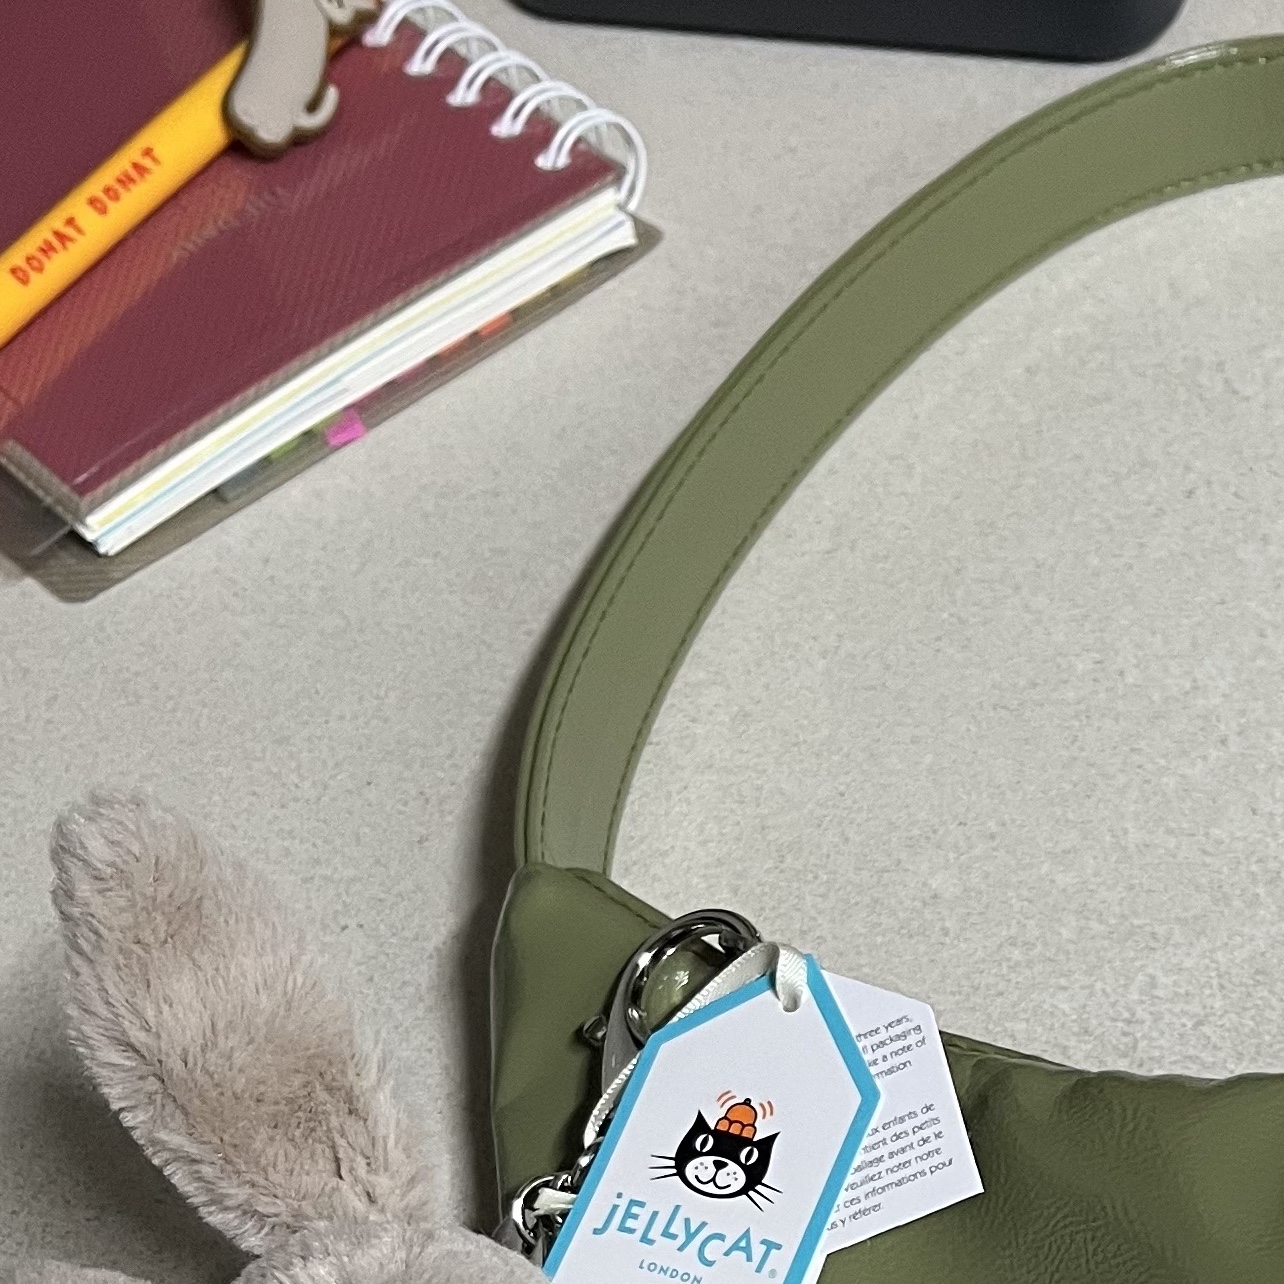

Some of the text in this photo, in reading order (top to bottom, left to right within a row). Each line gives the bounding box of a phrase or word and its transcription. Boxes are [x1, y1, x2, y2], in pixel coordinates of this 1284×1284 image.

[871, 1025, 922, 1053] packaging
[890, 1044, 913, 1058] note
[915, 1035, 927, 1047] of
[882, 1111, 918, 1130] enfants
[921, 1103, 935, 1114] de
[888, 1142, 915, 1159] avant
[917, 1136, 931, 1147] de
[933, 1130, 944, 1140] le
[891, 1130, 909, 1142] des
[886, 1159, 912, 1175] noter
[915, 1148, 942, 1163] notre
[844, 1196, 861, 1208] ces
[865, 1169, 927, 1200] informations
[929, 1158, 953, 1175] pour
[639, 1258, 703, 1284] LONDON
